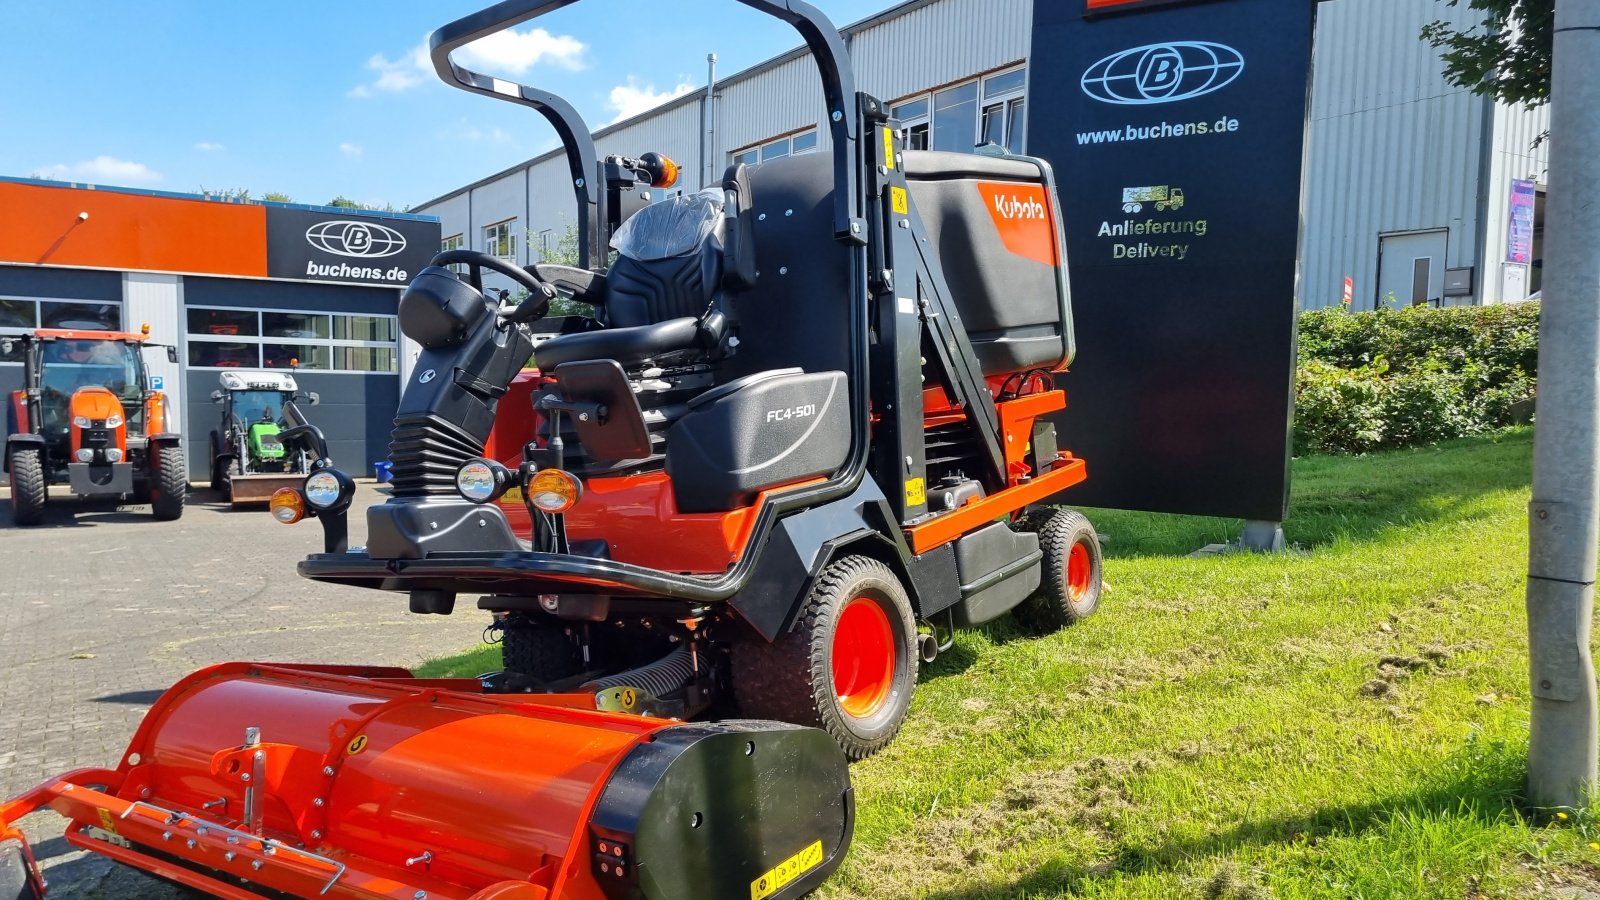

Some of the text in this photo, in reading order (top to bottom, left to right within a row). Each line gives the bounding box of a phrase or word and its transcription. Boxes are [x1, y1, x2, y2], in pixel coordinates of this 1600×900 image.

[1076, 116, 1239, 145] www.buchens.de
[994, 194, 1045, 219] Kubota
[1097, 219, 1208, 237] Anlieferung
[1113, 242, 1190, 260] Delivery
[306, 261, 408, 281] buchens.de
[151, 377, 162, 389] P
[766, 404, 816, 423] FC4-501
